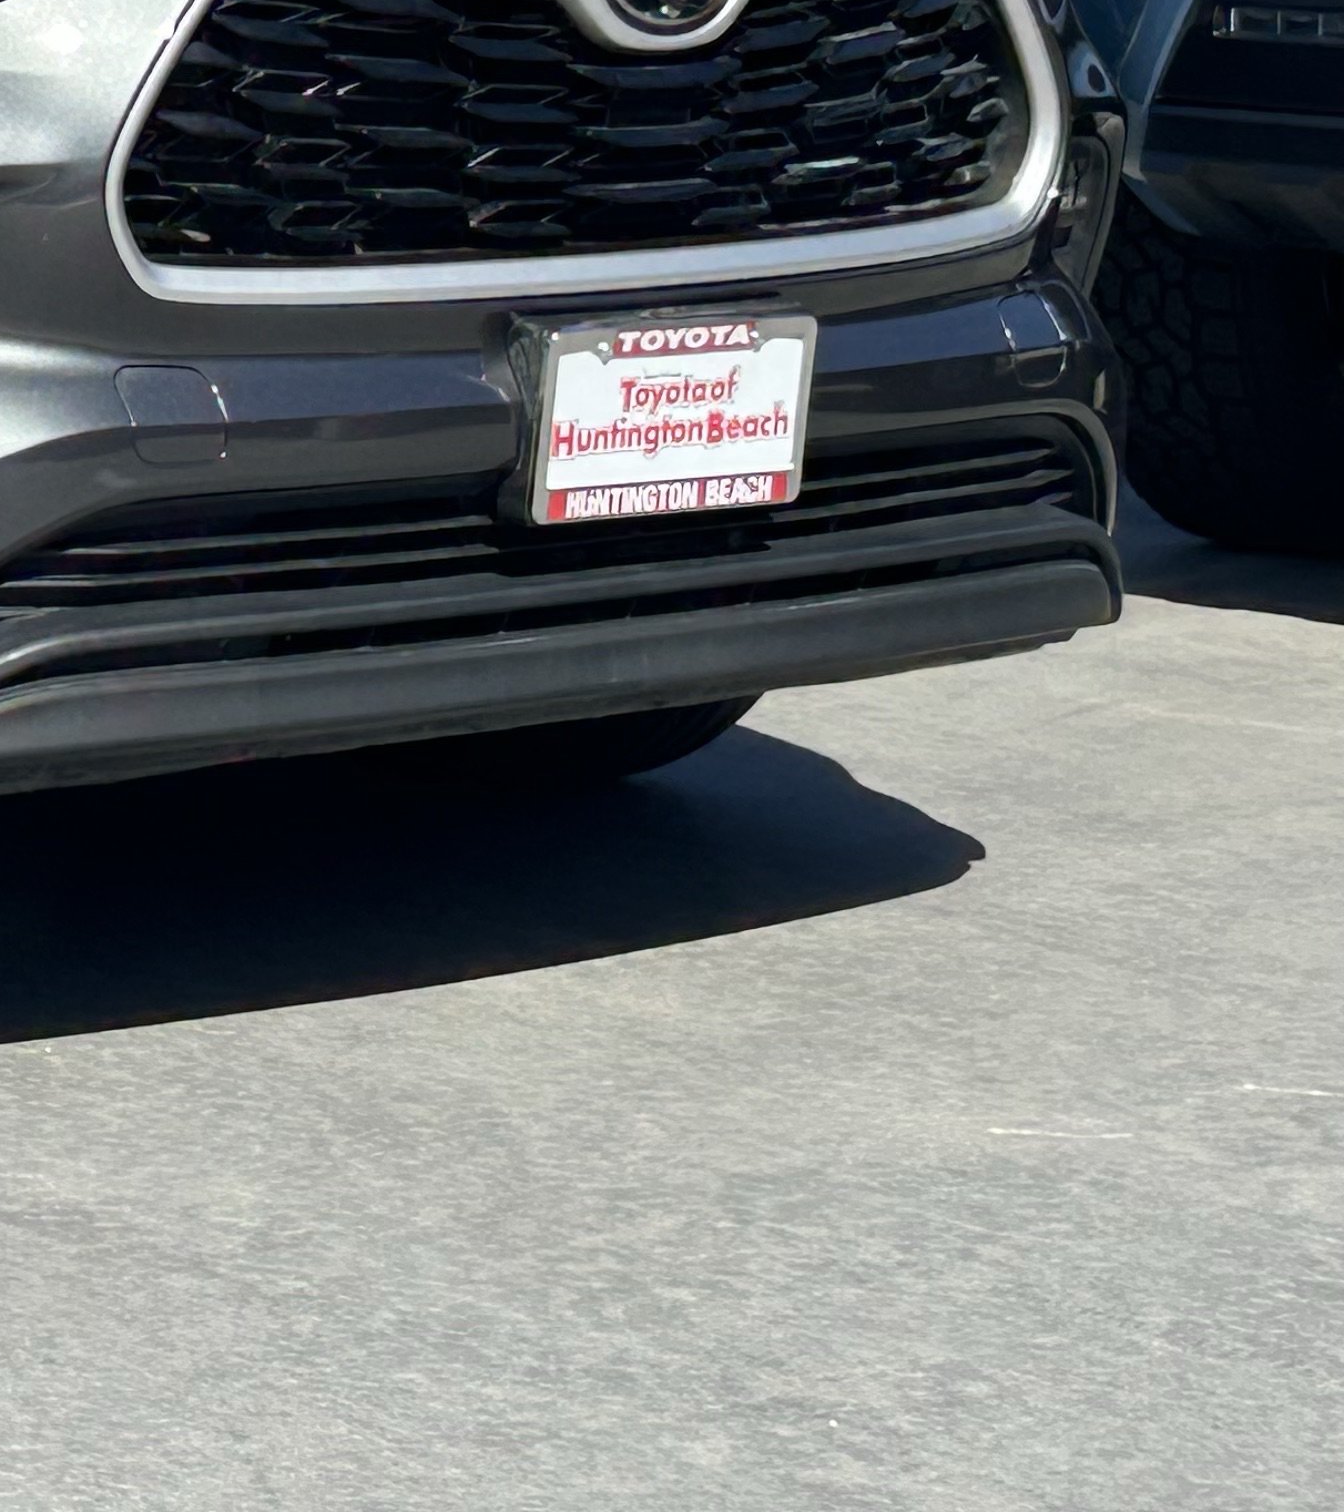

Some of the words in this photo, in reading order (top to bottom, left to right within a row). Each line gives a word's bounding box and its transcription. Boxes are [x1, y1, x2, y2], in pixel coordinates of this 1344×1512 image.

[618, 324, 751, 353] TOYOTA
[620, 375, 707, 415] Toyota
[710, 364, 741, 402] of
[551, 416, 703, 456] Huntington
[706, 402, 788, 444] Beach
[565, 481, 699, 519] HUNTINGTON
[704, 475, 773, 506] BEACH
